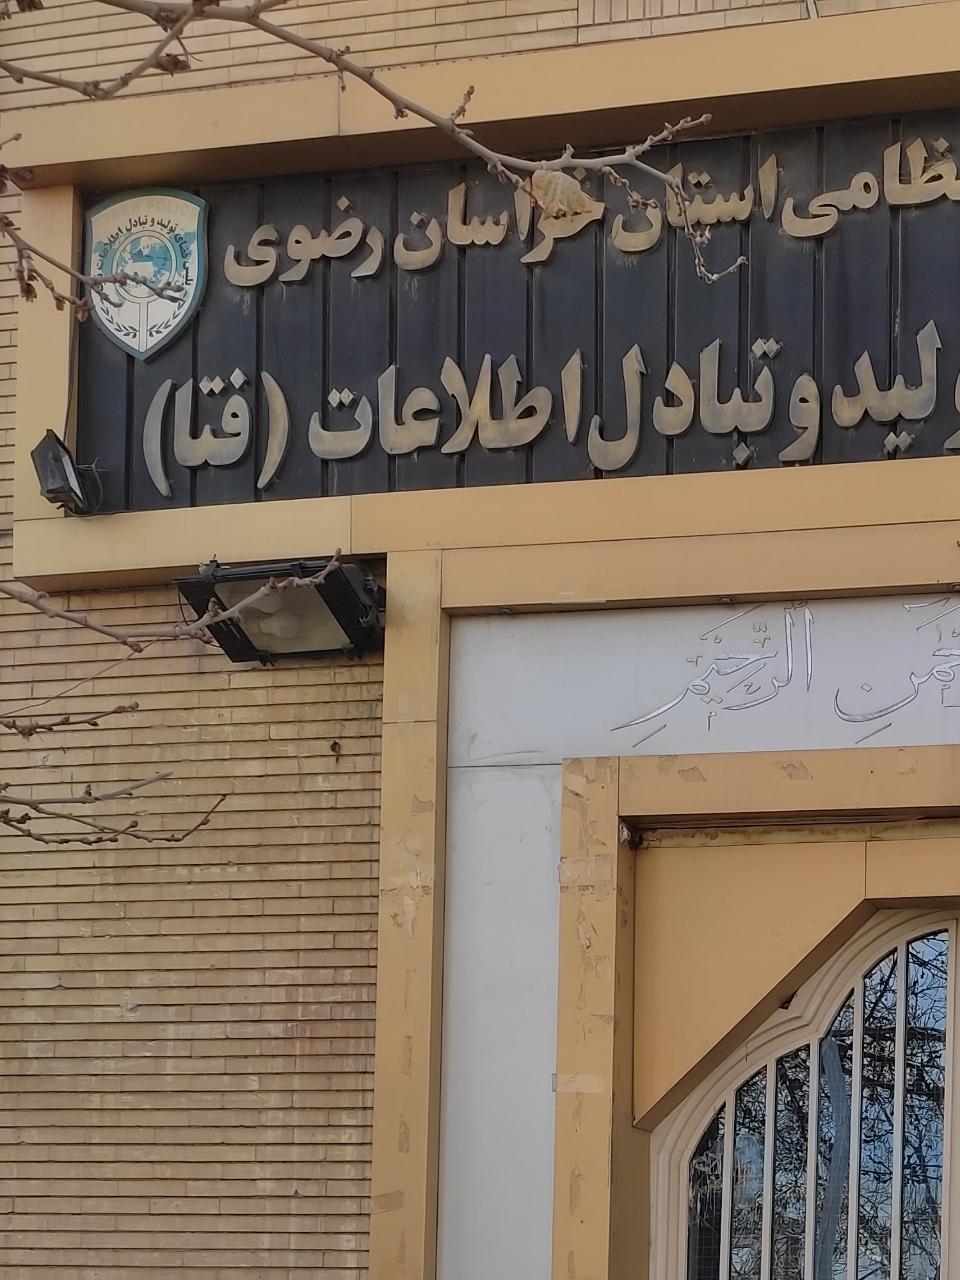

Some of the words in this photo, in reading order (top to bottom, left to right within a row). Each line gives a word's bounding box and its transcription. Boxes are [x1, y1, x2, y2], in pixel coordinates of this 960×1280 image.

[125, 214, 148, 232] تبادل
[224, 195, 384, 289] رضوی
[611, 152, 777, 253] استان
[142, 366, 290, 498] (فتا)
[308, 349, 581, 460] اطلاعات
[587, 337, 782, 471] تبادل
[778, 373, 823, 463] و
